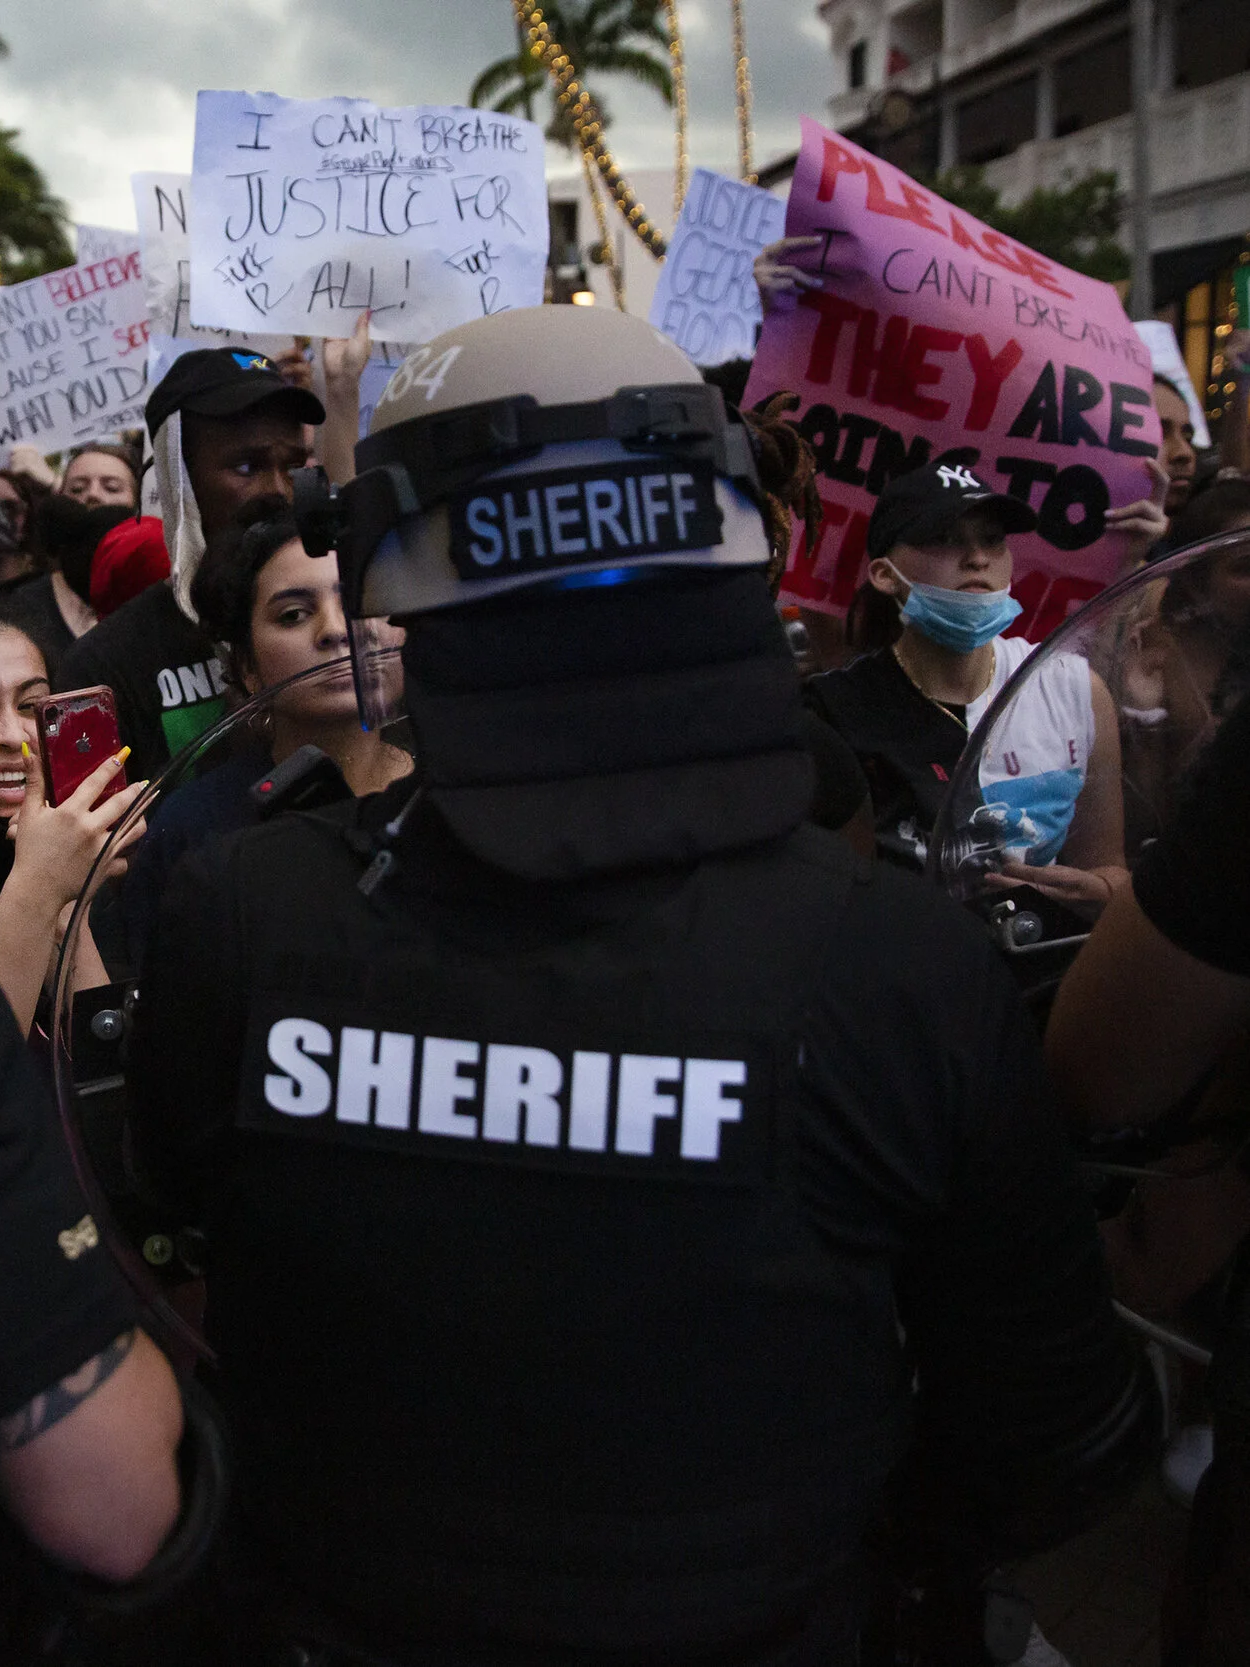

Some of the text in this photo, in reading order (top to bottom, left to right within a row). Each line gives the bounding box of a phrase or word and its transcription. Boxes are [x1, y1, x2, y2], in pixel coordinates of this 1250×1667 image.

[236, 111, 273, 150] I
[414, 114, 528, 154] BREATHE
[225, 170, 438, 242] JUSTICE
[452, 173, 526, 236] FOR
[817, 136, 1076, 301] PLEASE
[18, 316, 61, 353] YOU
[78, 336, 109, 367] I
[1011, 284, 1149, 369] BREATHE
[57, 374, 109, 423] YOU
[793, 290, 1159, 456] THEY ARE
[465, 472, 697, 568] SHERIFF
[996, 456, 1111, 551] TO
[264, 1017, 748, 1161] SHERIFF
